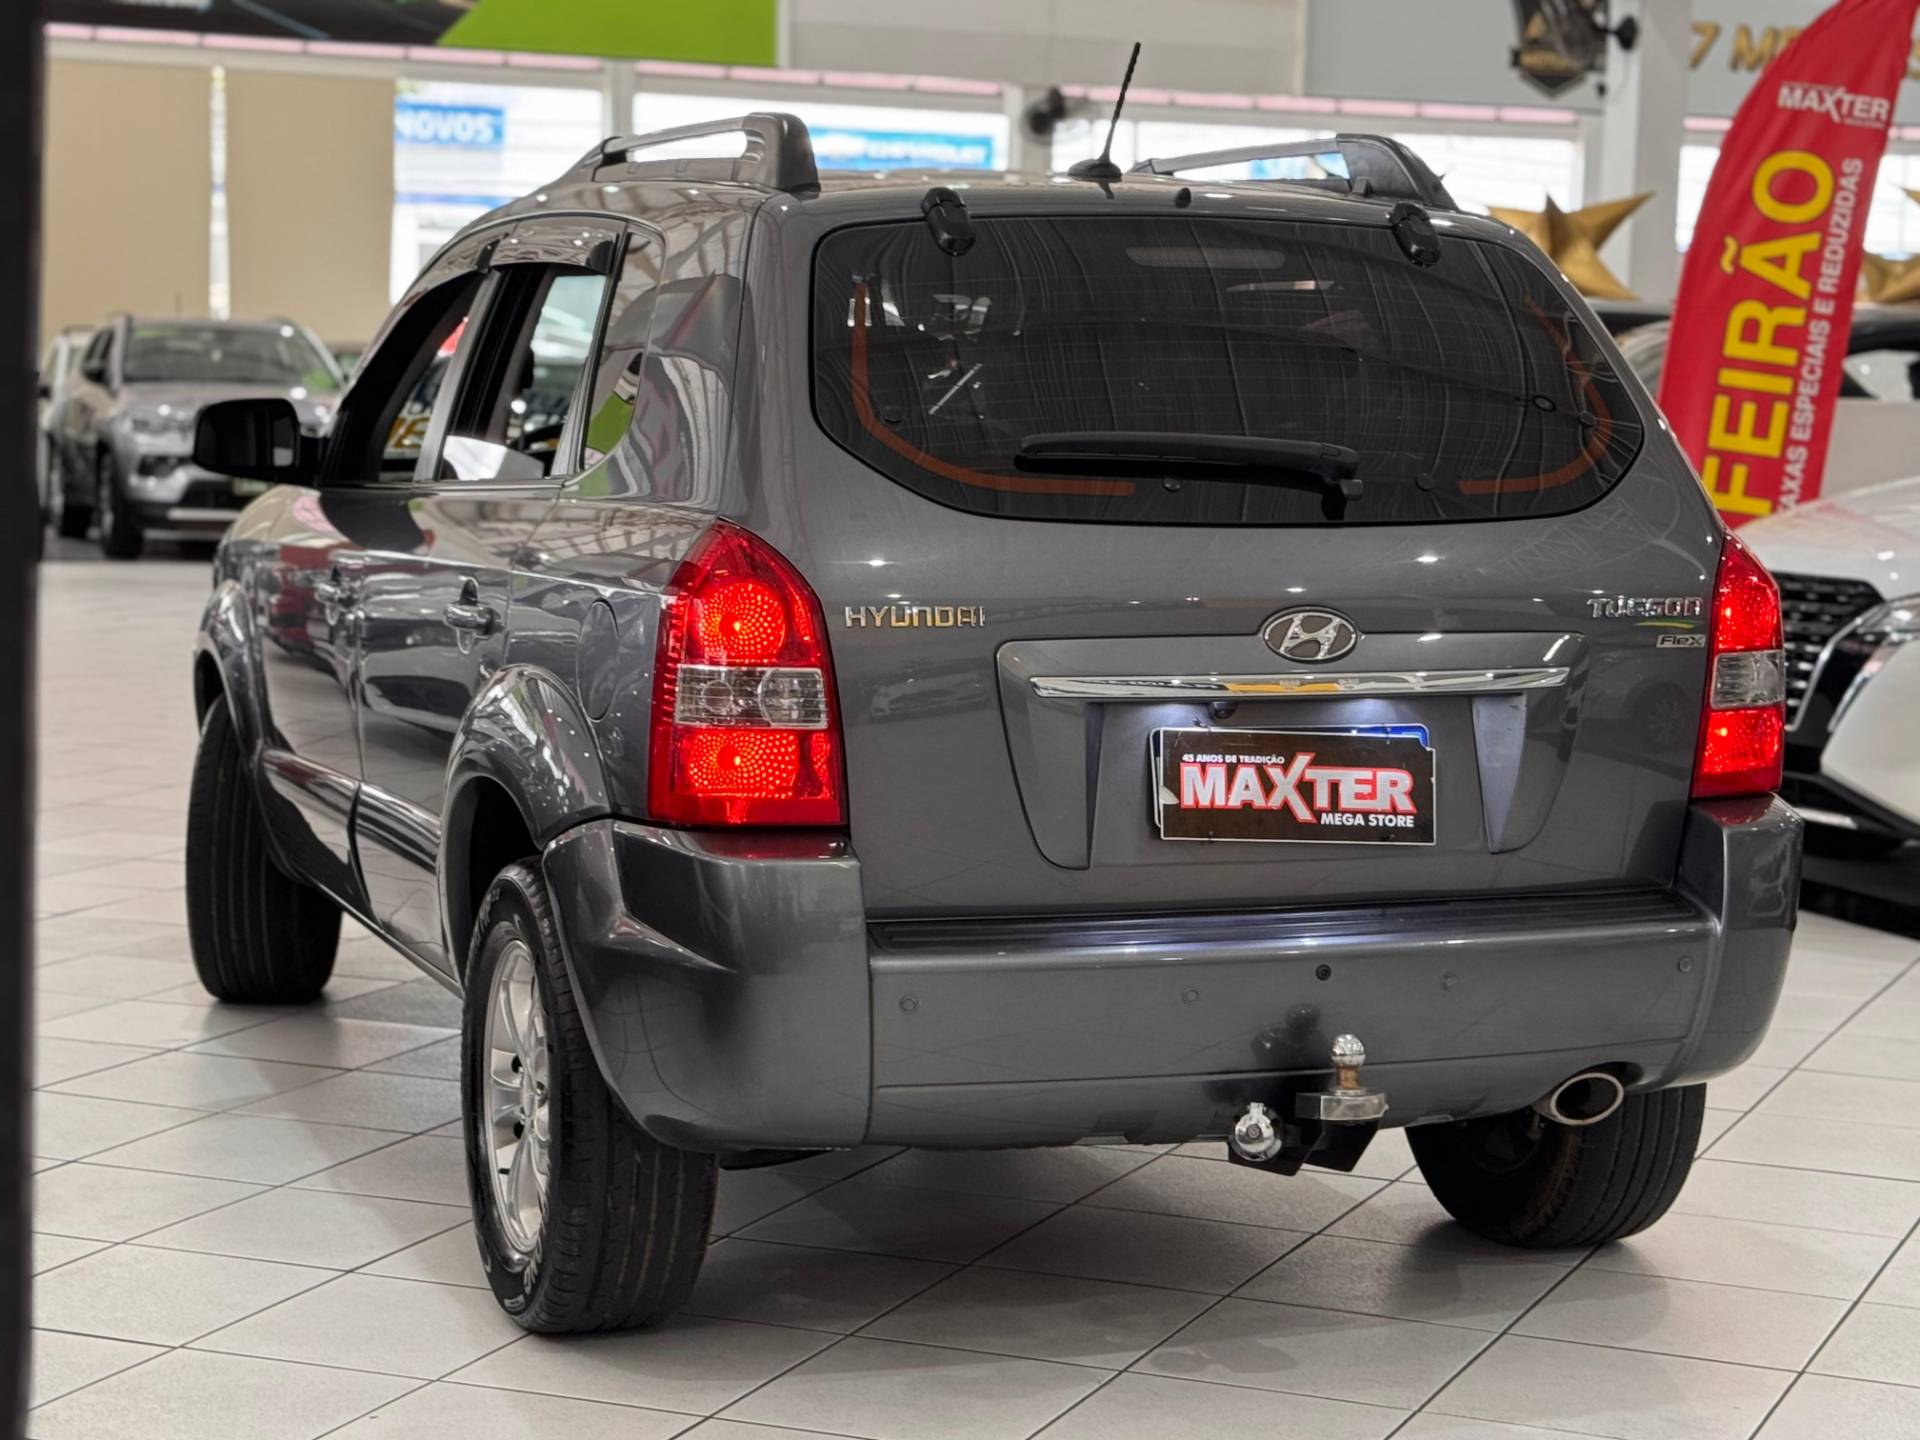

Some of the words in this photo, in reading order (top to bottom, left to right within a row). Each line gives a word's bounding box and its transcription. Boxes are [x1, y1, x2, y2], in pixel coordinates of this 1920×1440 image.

[1690, 20, 1720, 69] 7
[1778, 85, 1889, 124] MAXTER
[1817, 157, 1863, 294] REDUZIDAS
[1813, 298, 1835, 315] E
[1701, 150, 1834, 518] FEIRÃO
[1789, 319, 1831, 441] ESPECIAIS
[1776, 445, 1808, 512] AXAS
[844, 605, 986, 627] HYUNDAI
[1182, 753, 1195, 762] 45
[1196, 754, 1224, 763] ANOS
[1225, 754, 1238, 763] DE
[1239, 754, 1286, 766] TRADIÇÃO
[1180, 752, 1418, 824] MAXTER
[1320, 812, 1365, 826] MEGA
[1368, 814, 1415, 828] STORE
